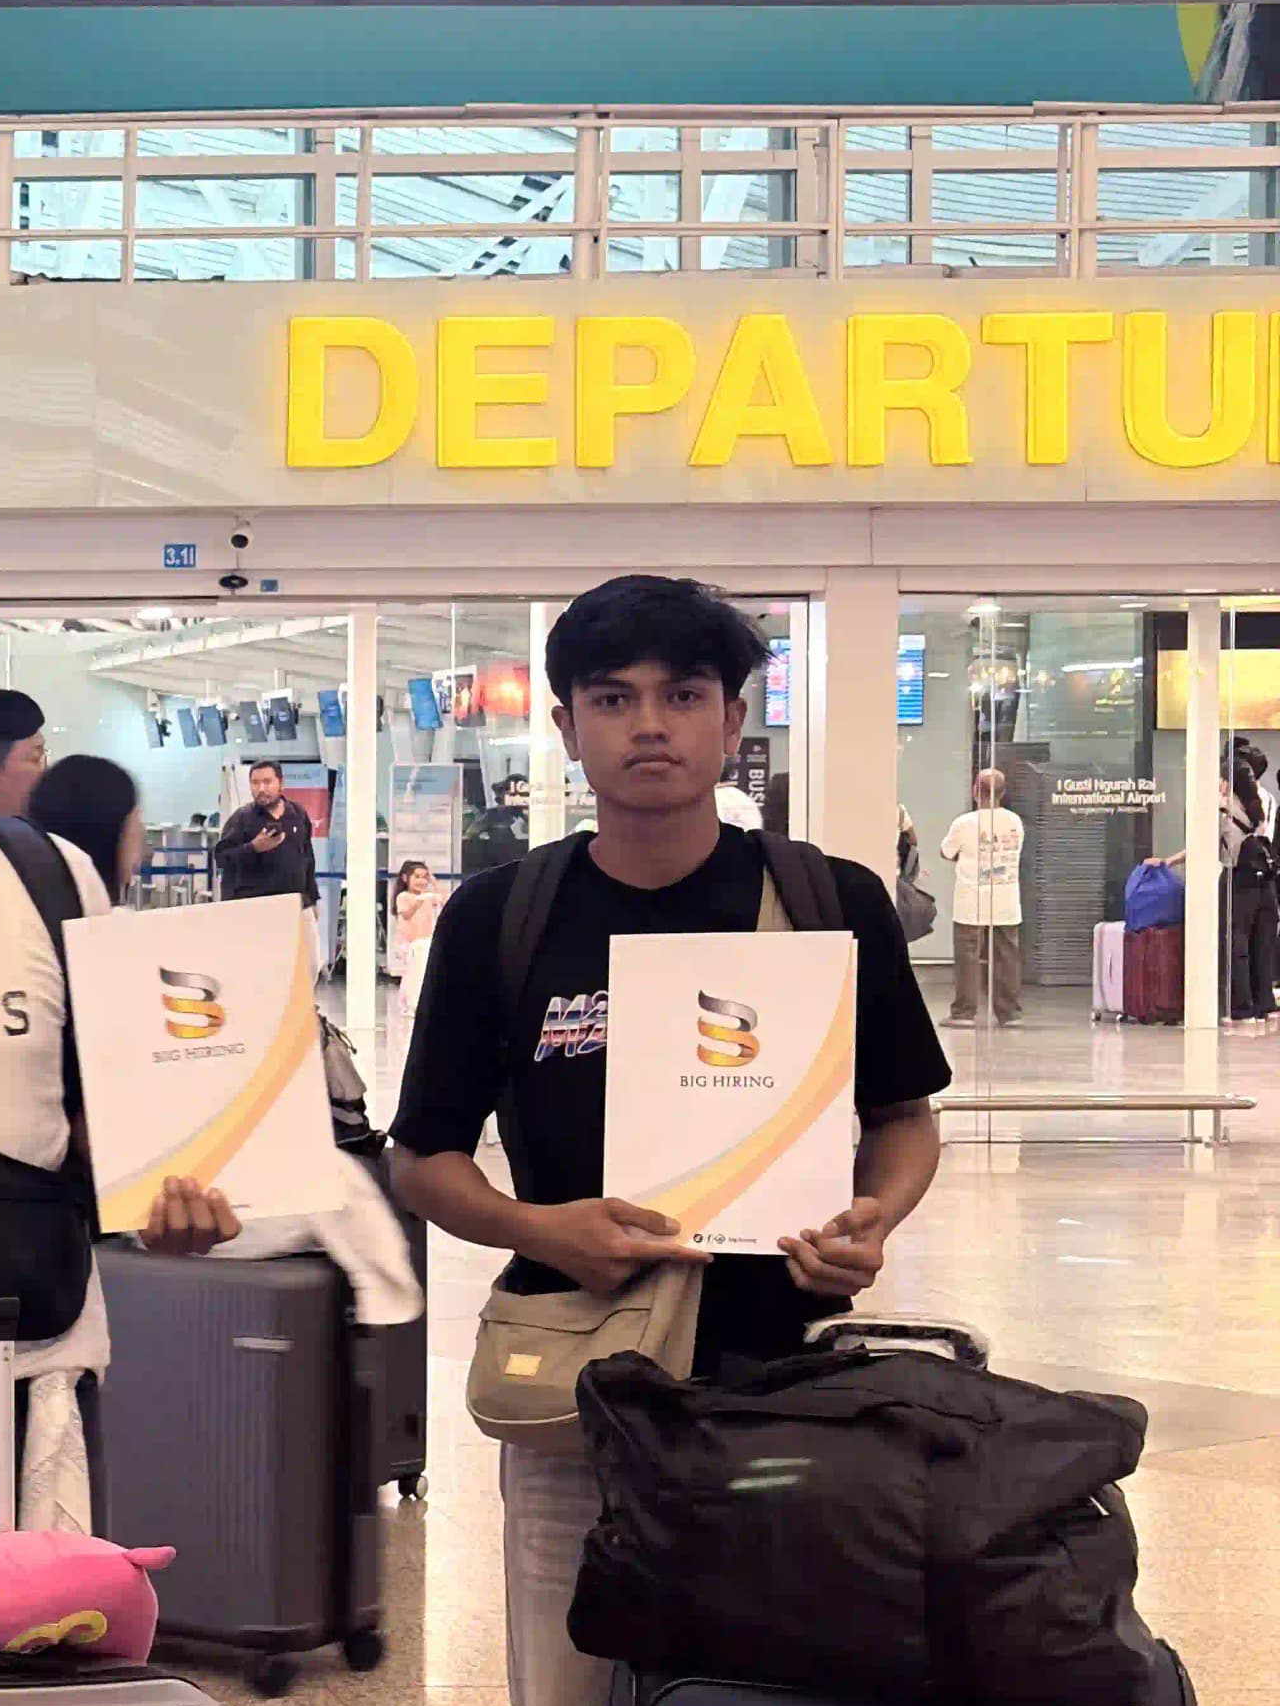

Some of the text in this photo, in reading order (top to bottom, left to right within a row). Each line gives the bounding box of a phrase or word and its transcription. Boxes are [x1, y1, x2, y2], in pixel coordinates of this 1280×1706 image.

[285, 310, 1280, 469] DEPARTU
[1064, 779, 1092, 792] Gusti
[1094, 779, 1136, 795] Ngurah
[1138, 778, 1157, 792] Rai
[1052, 792, 1167, 807] International Airport
[679, 1075, 775, 1089] BIG HIRING
